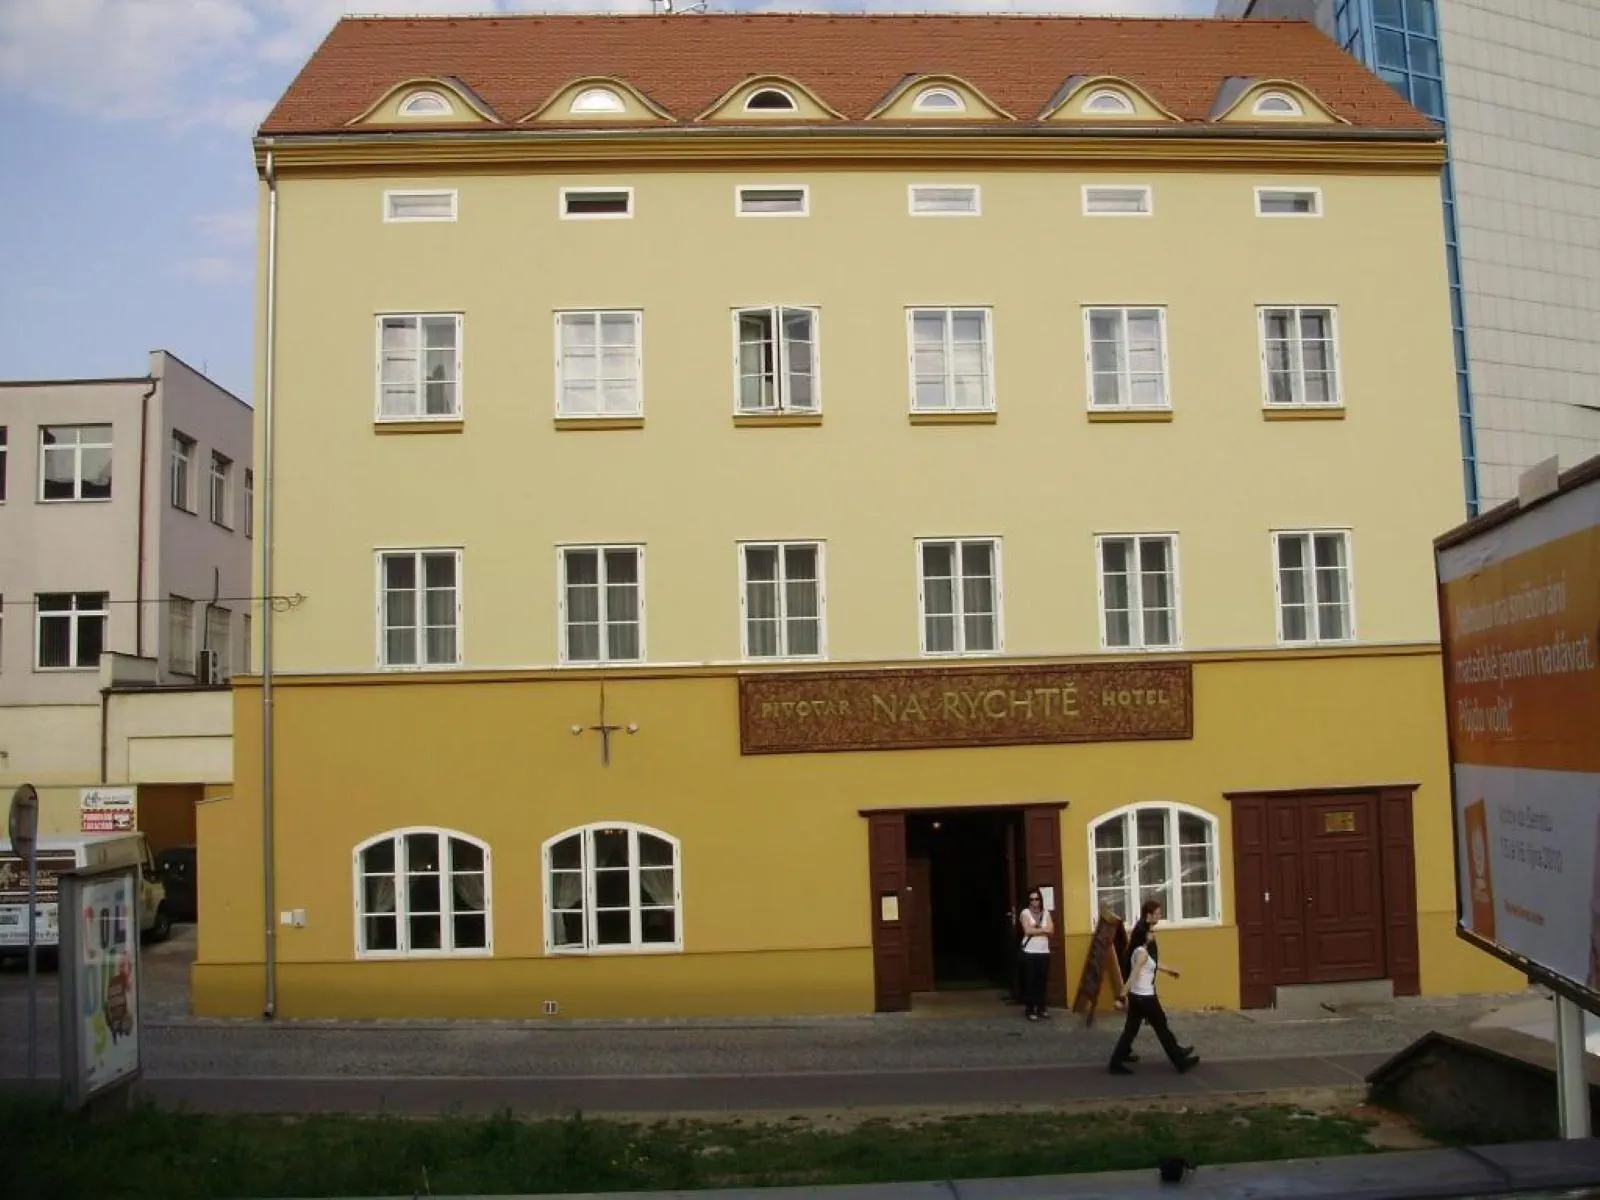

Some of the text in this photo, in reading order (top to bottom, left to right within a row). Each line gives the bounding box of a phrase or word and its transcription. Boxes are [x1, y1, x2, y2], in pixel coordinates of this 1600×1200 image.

[872, 692, 926, 723] NA
[942, 681, 1081, 721] RYCHTĚ
[1101, 688, 1170, 706] HOTEL
